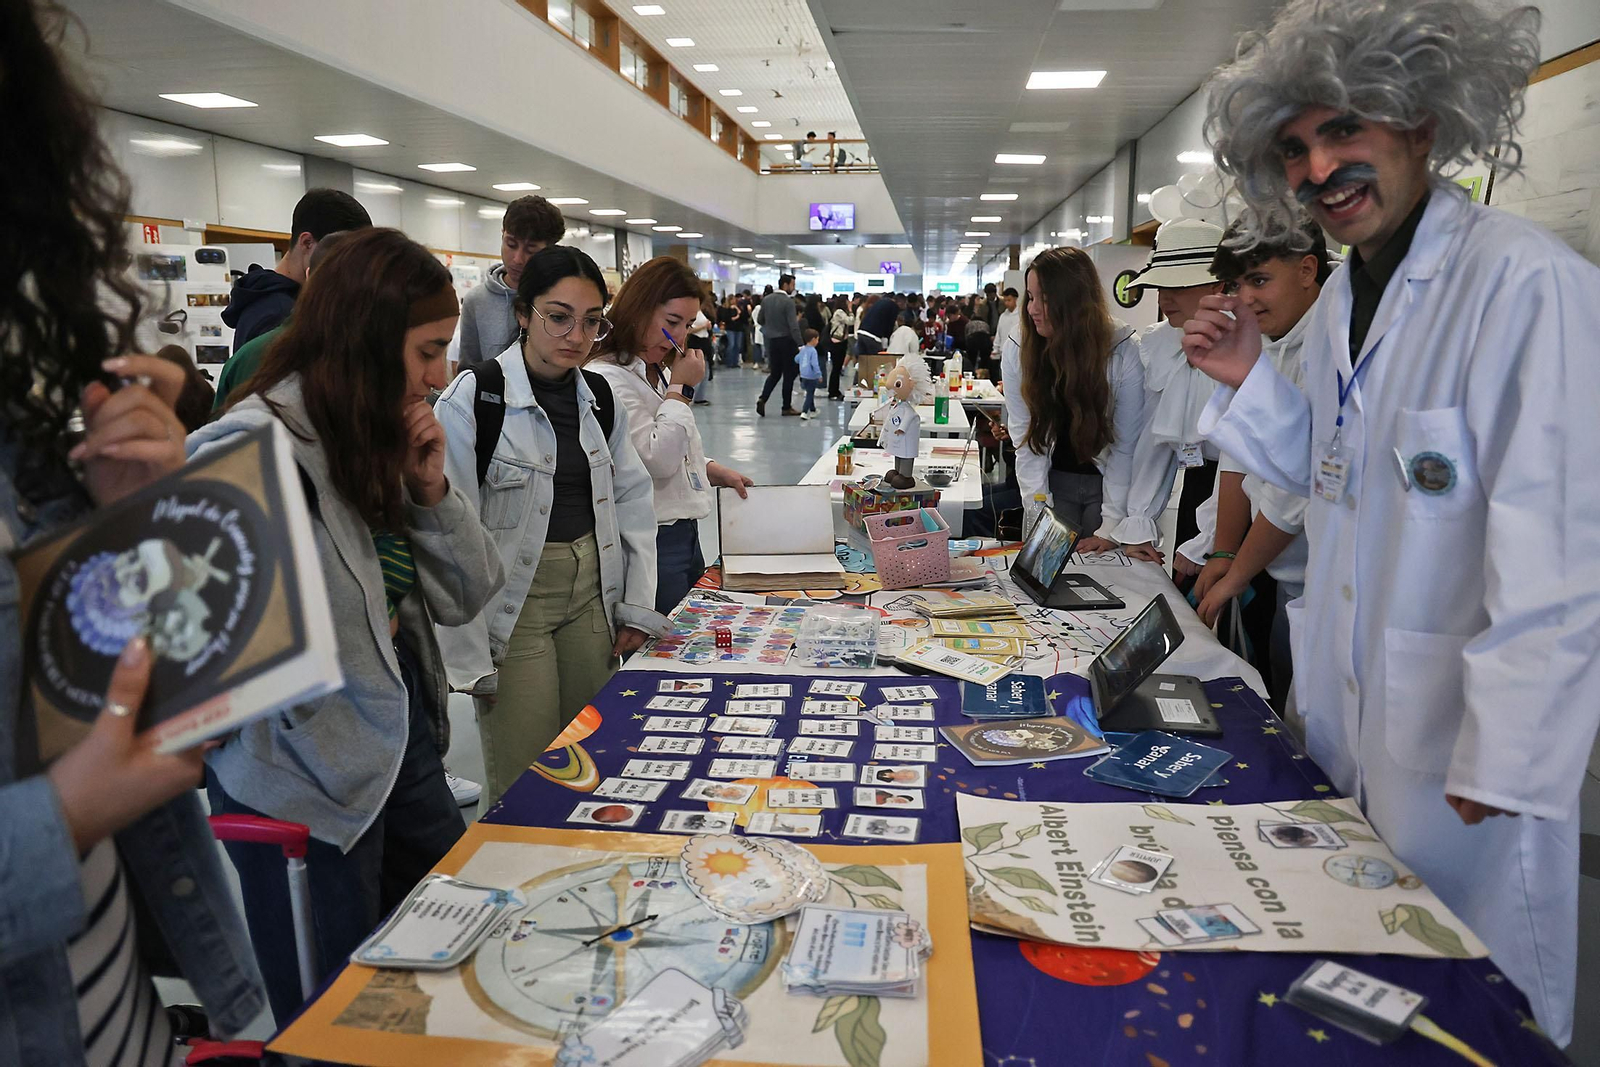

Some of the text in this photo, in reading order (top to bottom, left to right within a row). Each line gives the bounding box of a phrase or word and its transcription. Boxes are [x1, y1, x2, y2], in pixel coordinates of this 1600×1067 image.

[1010, 681, 1026, 700] Saber
[1154, 752, 1202, 779] Saber y
[1039, 805, 1078, 856] Albert
[1055, 861, 1106, 942] Einstein
[1206, 816, 1304, 939] piensa con la
